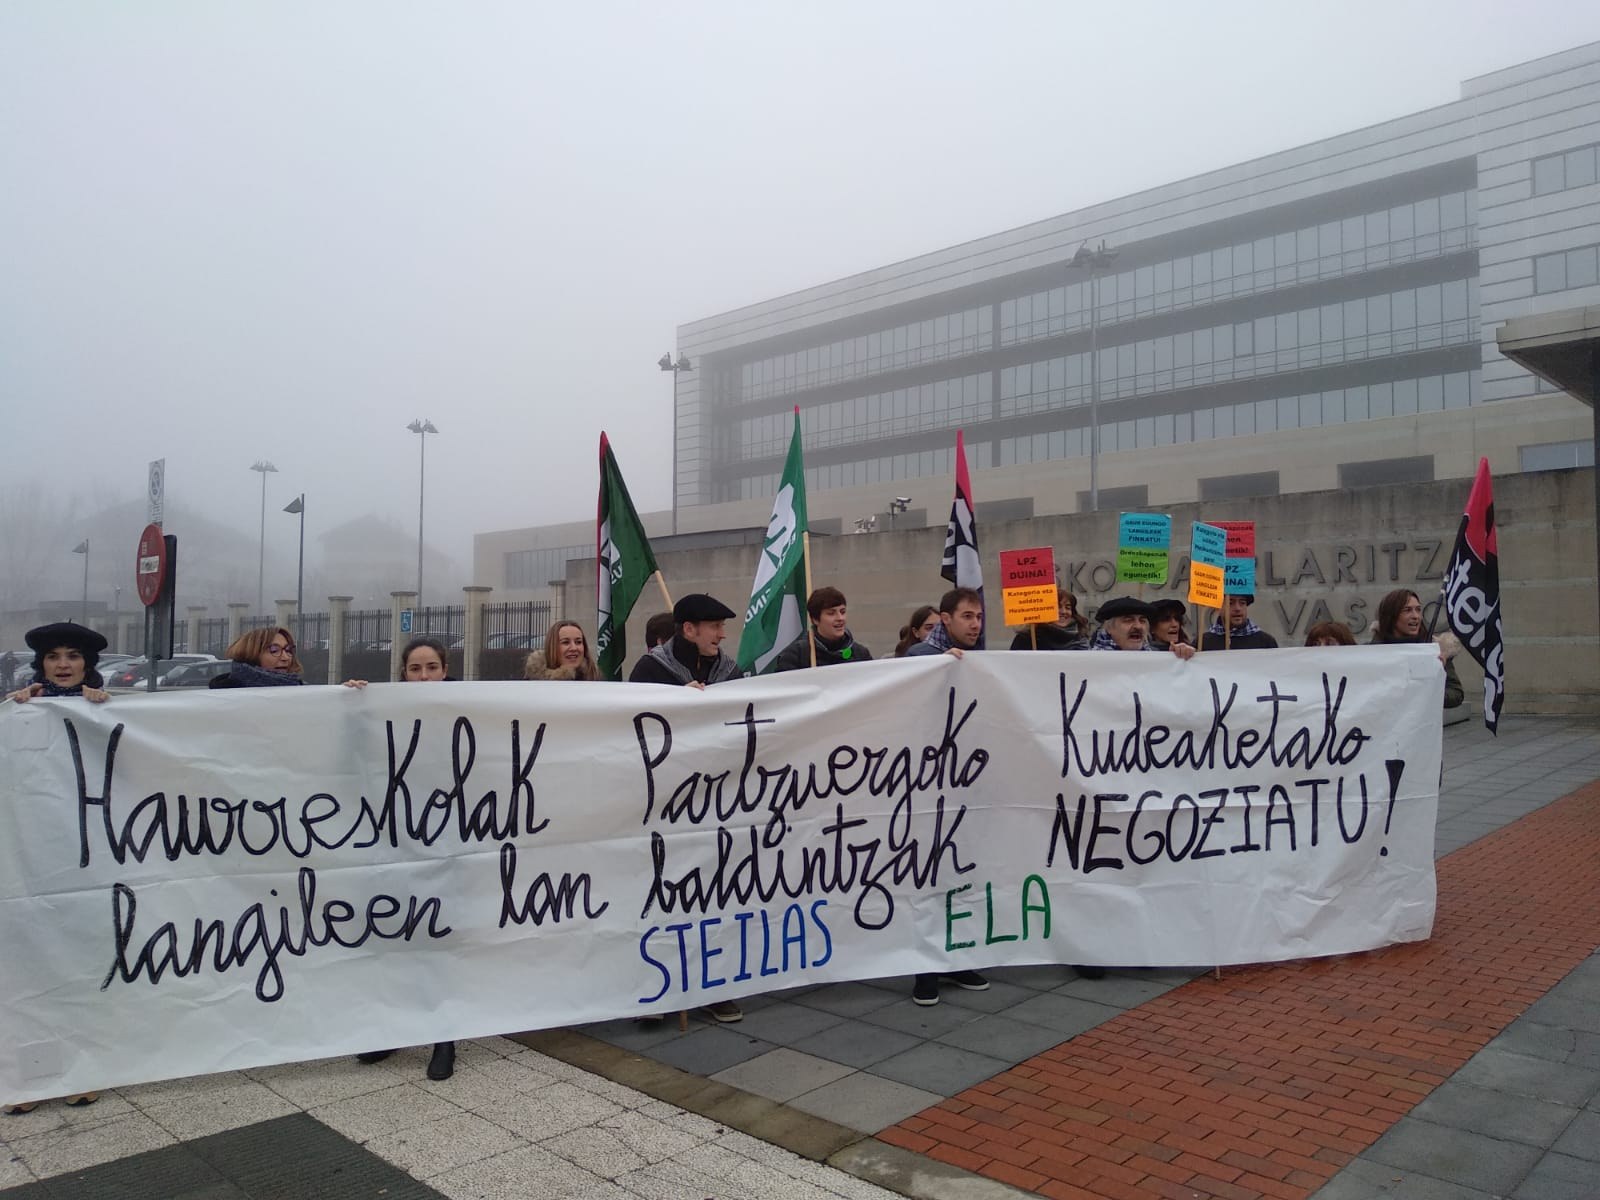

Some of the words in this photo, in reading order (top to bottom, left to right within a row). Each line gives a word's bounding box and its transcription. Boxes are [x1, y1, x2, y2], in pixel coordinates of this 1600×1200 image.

[1017, 556, 1037, 566] LPZ
[1225, 565, 1239, 573] PZ
[1009, 569, 1047, 580] DUINA!
[1226, 578, 1247, 586] INA!
[101, 867, 451, 1002] langileen
[500, 846, 608, 929] lan
[1046, 759, 1406, 873] NEGOZIATU!
[638, 899, 833, 1004] STEILAS
[945, 873, 1052, 953] ELA
